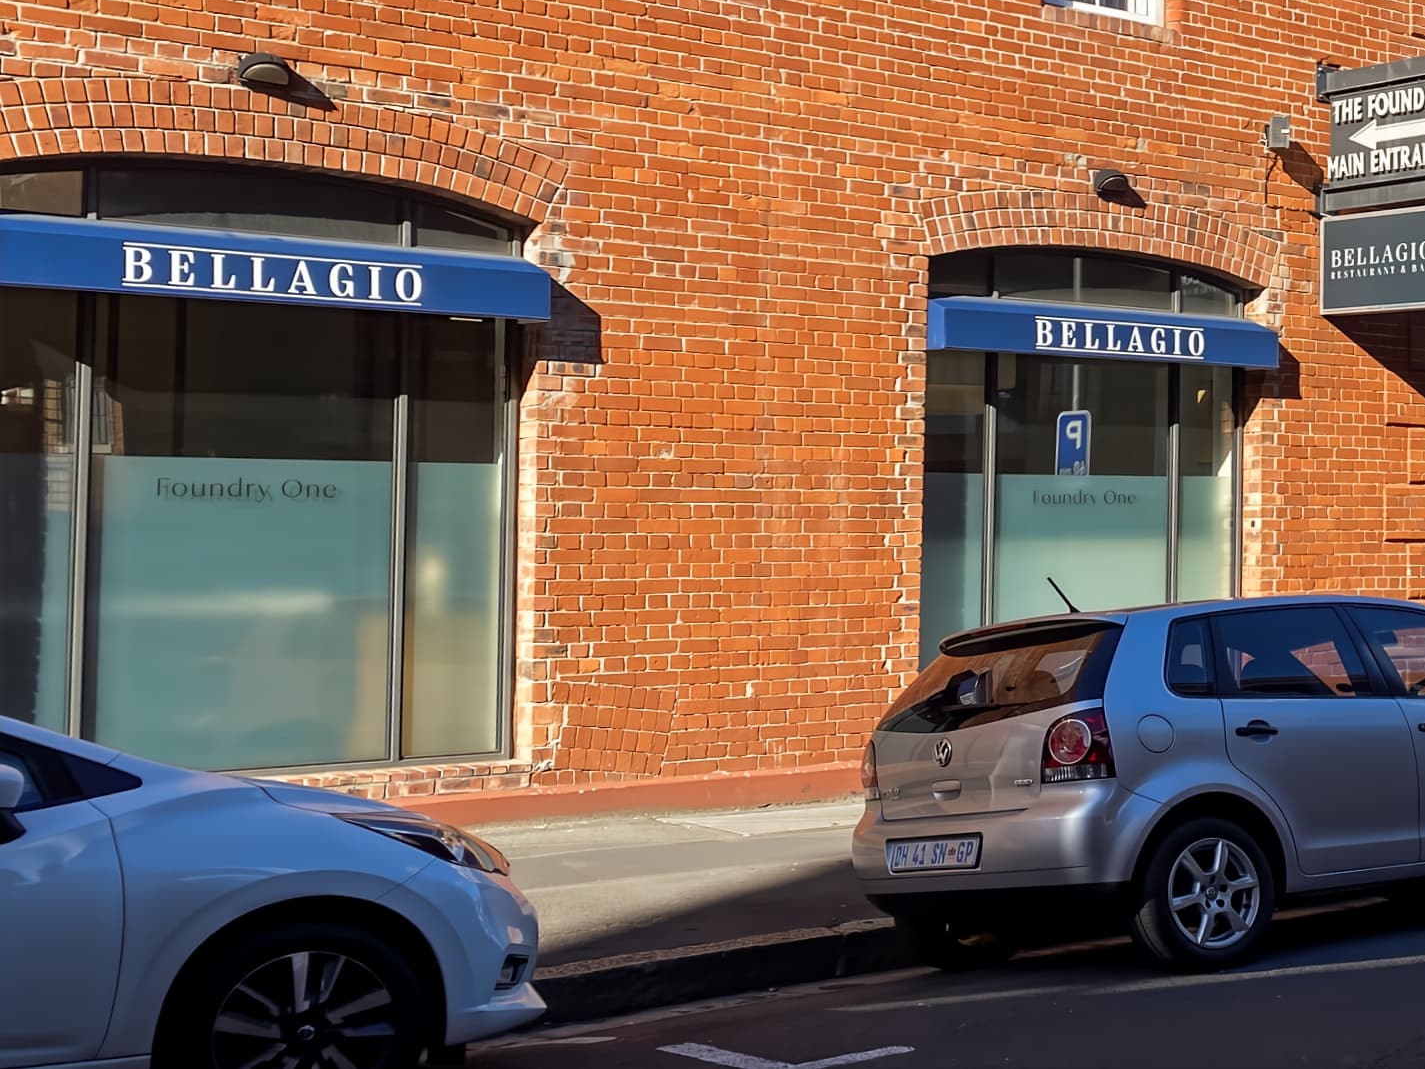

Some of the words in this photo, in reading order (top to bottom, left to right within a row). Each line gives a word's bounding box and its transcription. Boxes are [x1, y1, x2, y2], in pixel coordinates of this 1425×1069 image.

[1332, 96, 1363, 124] THE
[1327, 151, 1365, 180] MAIN
[121, 246, 423, 302] BELLAGIO
[1330, 265, 1396, 280] RESTAURANT
[1035, 319, 1206, 356] BELLAGIO
[156, 477, 266, 503] Foundry
[281, 479, 337, 499] One
[1103, 490, 1137, 505] One
[912, 844, 926, 865] 41
[931, 842, 948, 864] SN
[956, 841, 973, 863] GP
